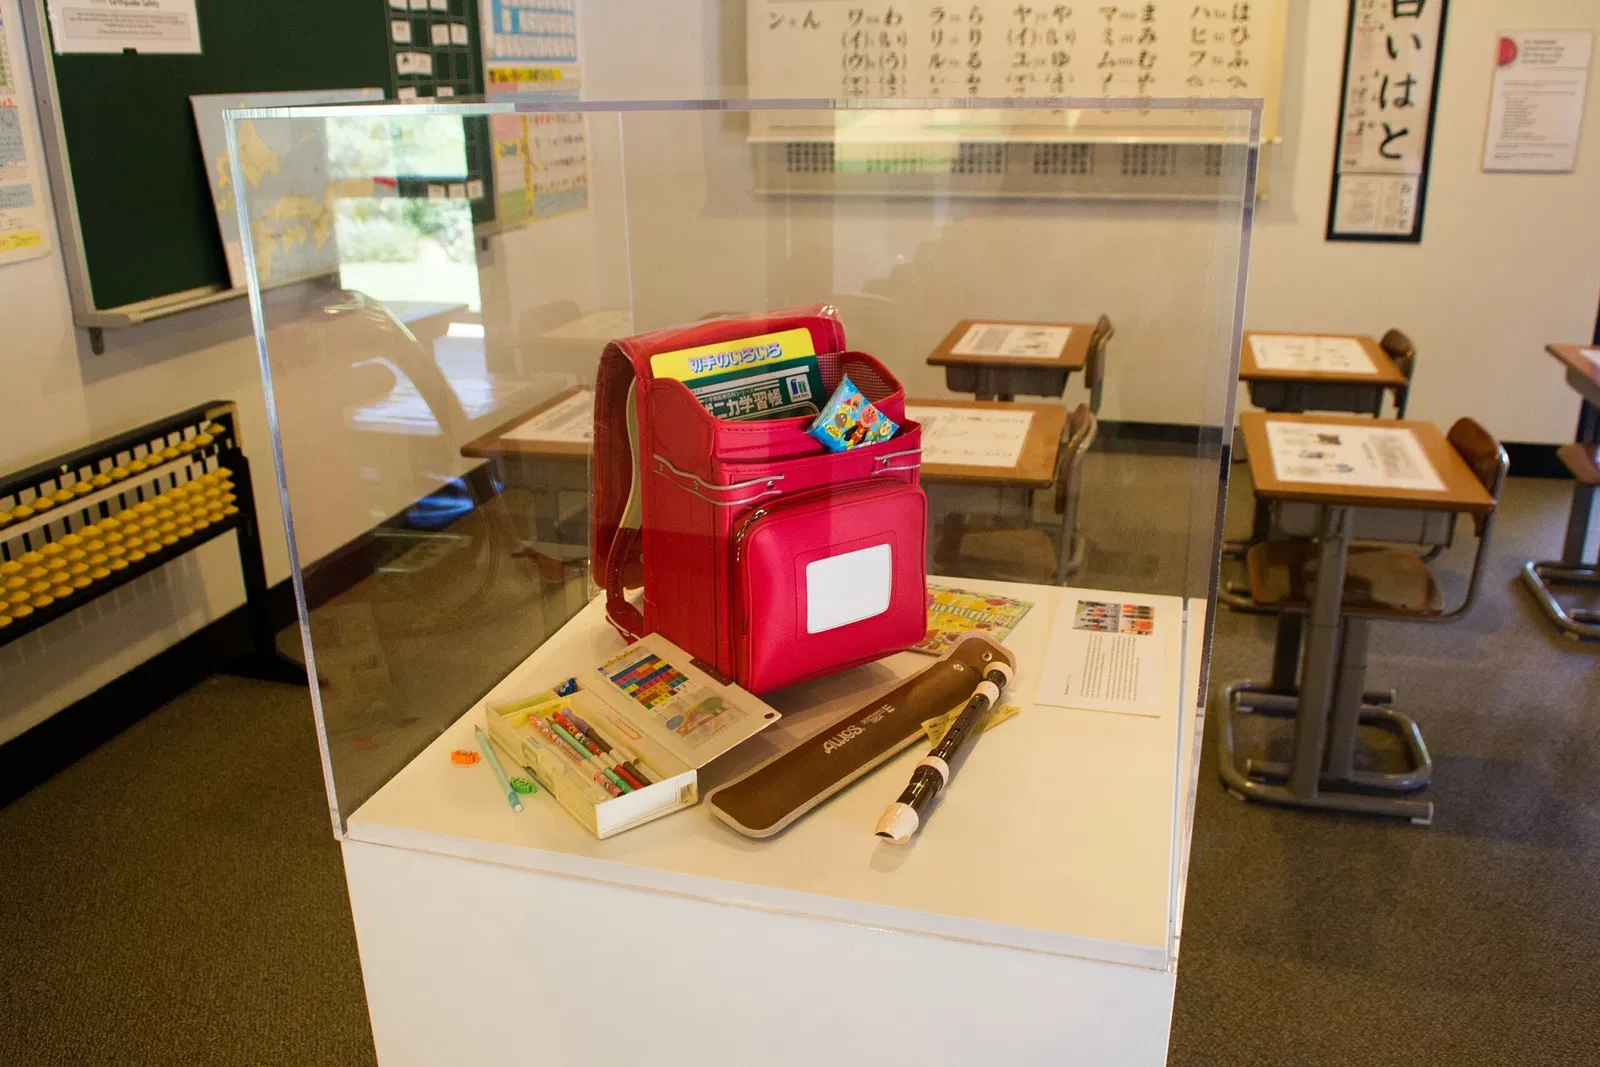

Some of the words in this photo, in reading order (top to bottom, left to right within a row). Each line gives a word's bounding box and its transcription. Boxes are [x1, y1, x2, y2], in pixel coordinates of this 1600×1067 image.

[689, 342, 782, 373] 切手のいろいろ
